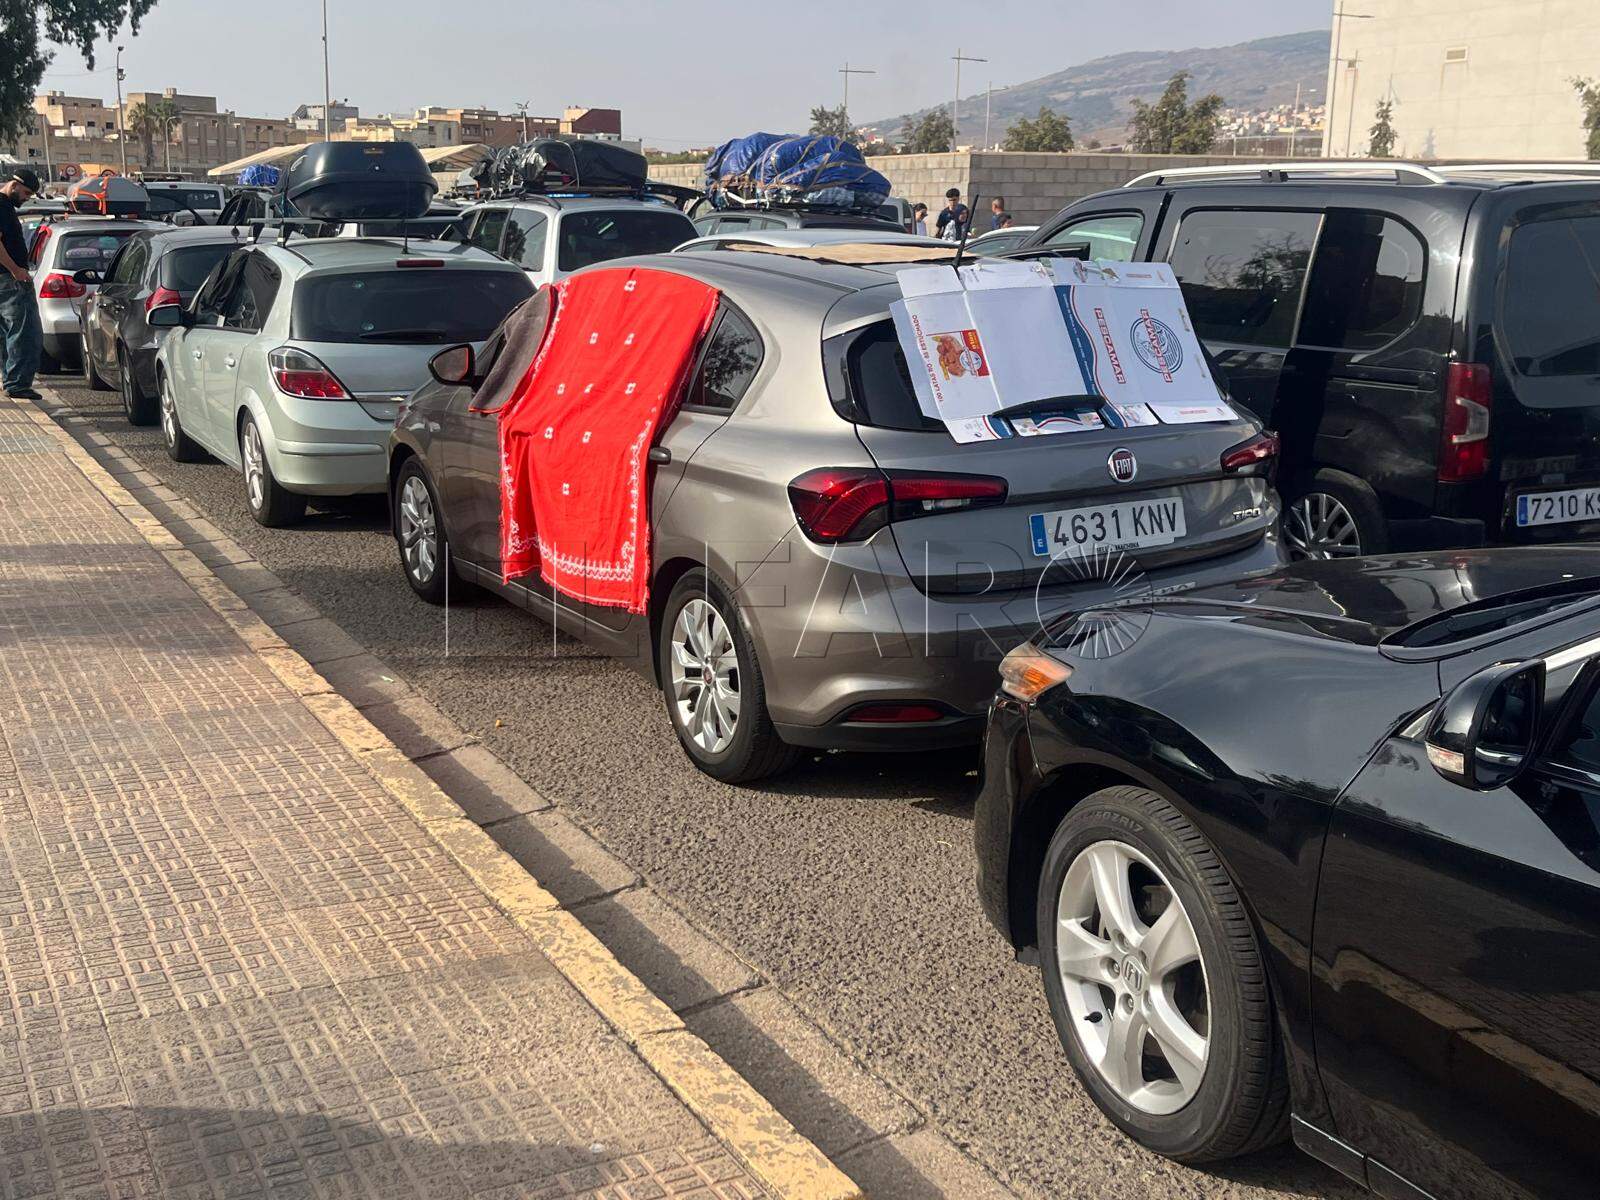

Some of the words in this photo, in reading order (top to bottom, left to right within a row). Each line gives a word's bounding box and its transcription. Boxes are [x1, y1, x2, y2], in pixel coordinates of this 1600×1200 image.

[1094, 308, 1126, 384] PESCAMAR
[1140, 309, 1173, 383] PESCAMAR
[1115, 458, 1132, 475] FIAT
[1037, 538, 1044, 548] E
[1054, 509, 1122, 547] 4631
[1132, 502, 1177, 537] KNV
[1531, 495, 1578, 521] 7210
